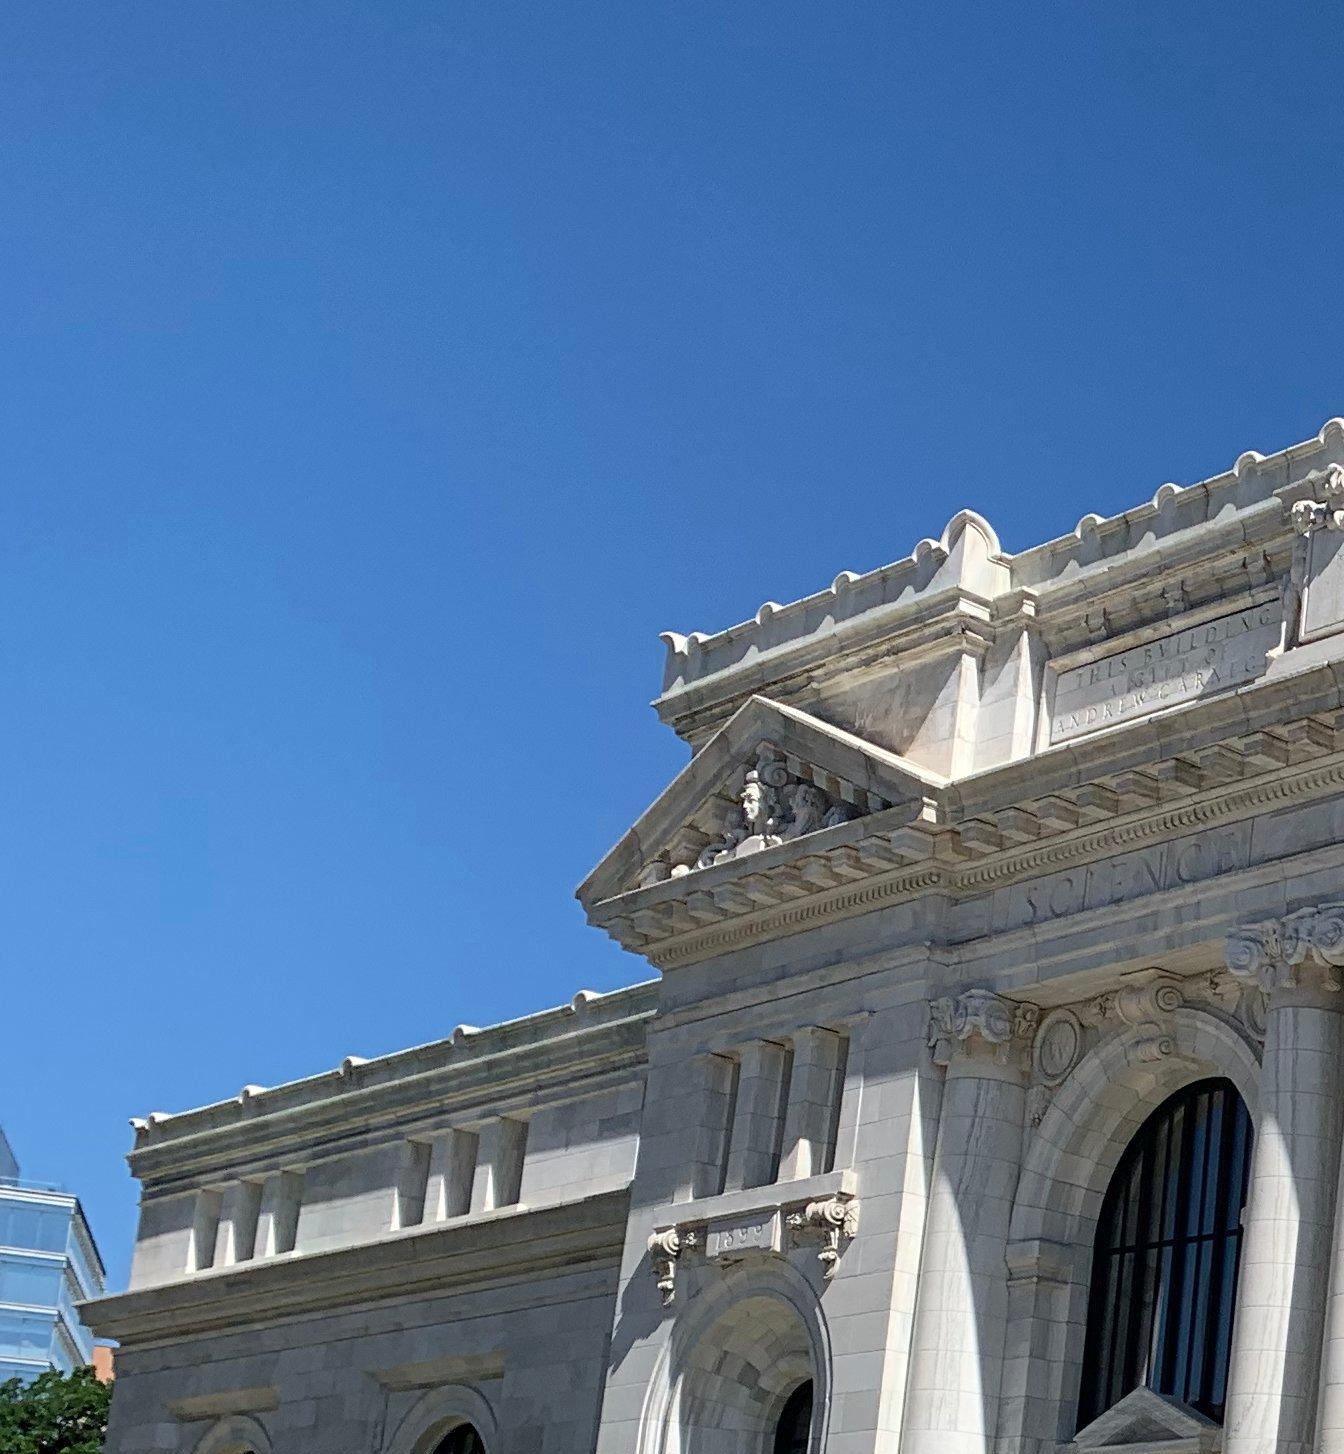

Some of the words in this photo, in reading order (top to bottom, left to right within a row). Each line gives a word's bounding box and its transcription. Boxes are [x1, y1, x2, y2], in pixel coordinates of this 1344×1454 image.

[1075, 655, 1128, 689] THIS
[1055, 690, 1147, 734] ANDREW
[1025, 829, 1237, 920] SCIENCE
